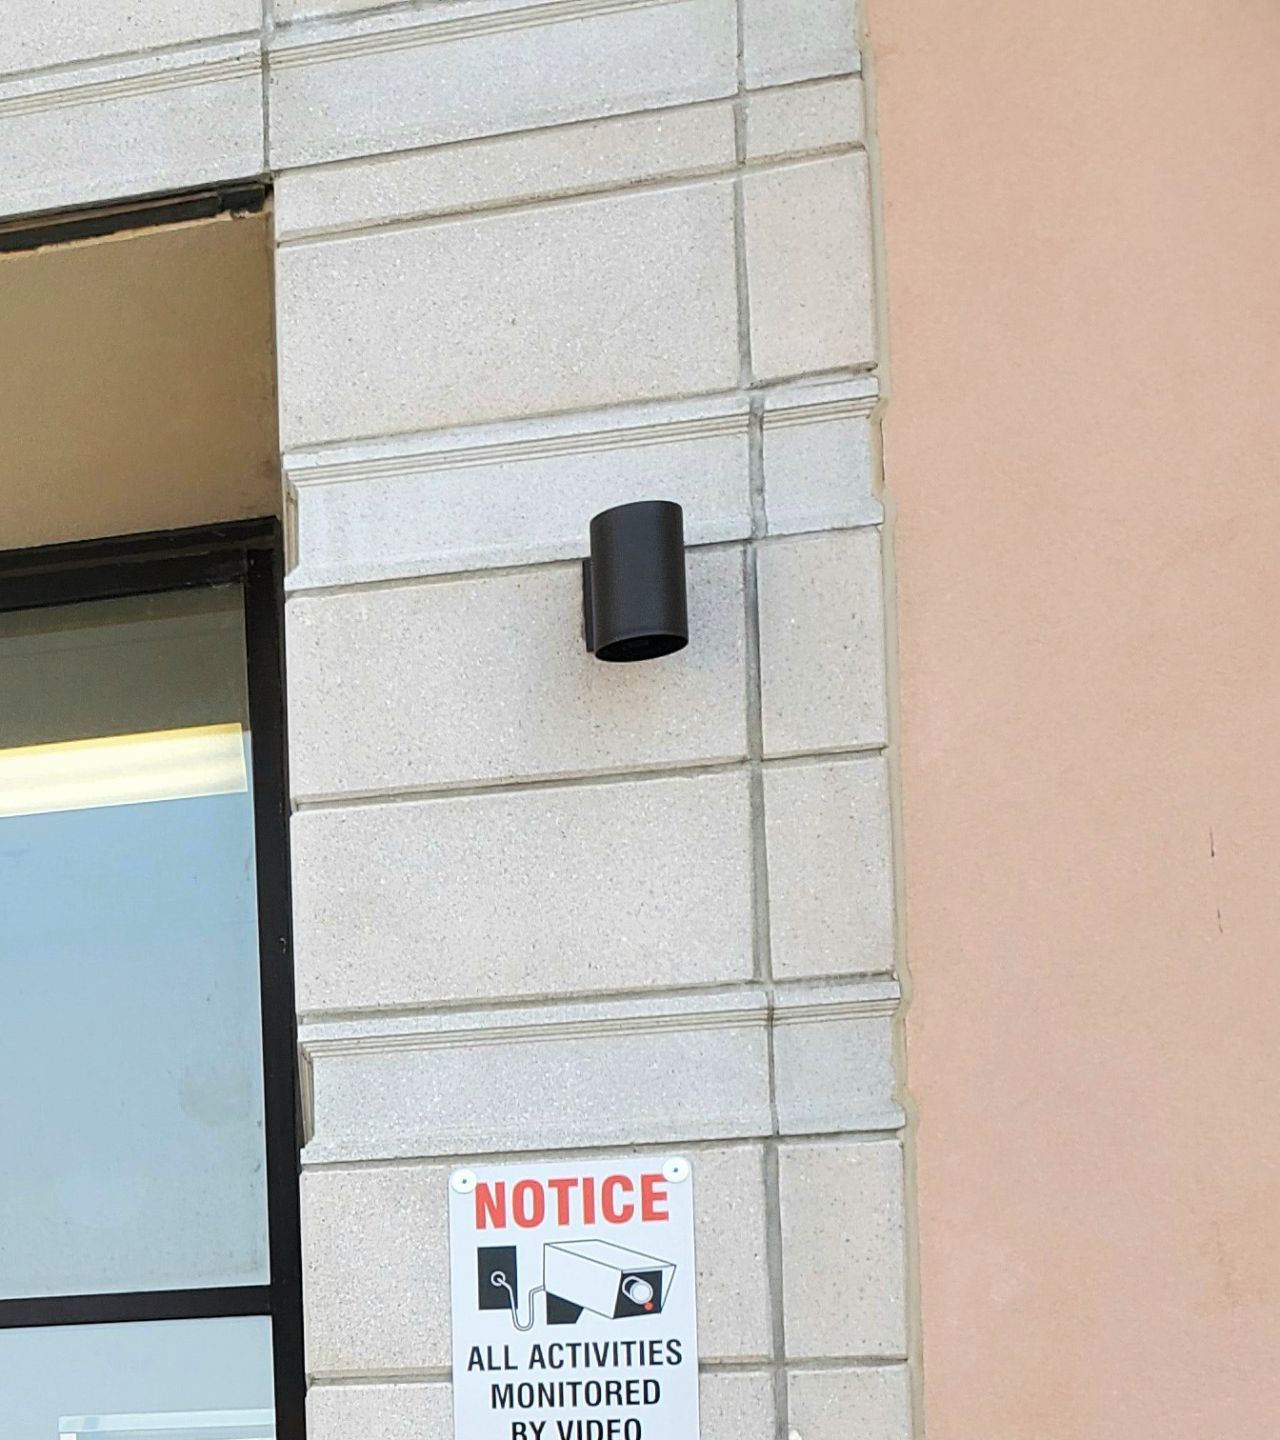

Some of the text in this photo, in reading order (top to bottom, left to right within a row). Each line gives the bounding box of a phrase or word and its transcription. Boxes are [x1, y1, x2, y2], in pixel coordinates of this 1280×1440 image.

[474, 1174, 670, 1230] NOTICE
[467, 1339, 683, 1371] ALL ACTIVITIES
[490, 1379, 661, 1410] MONITORED
